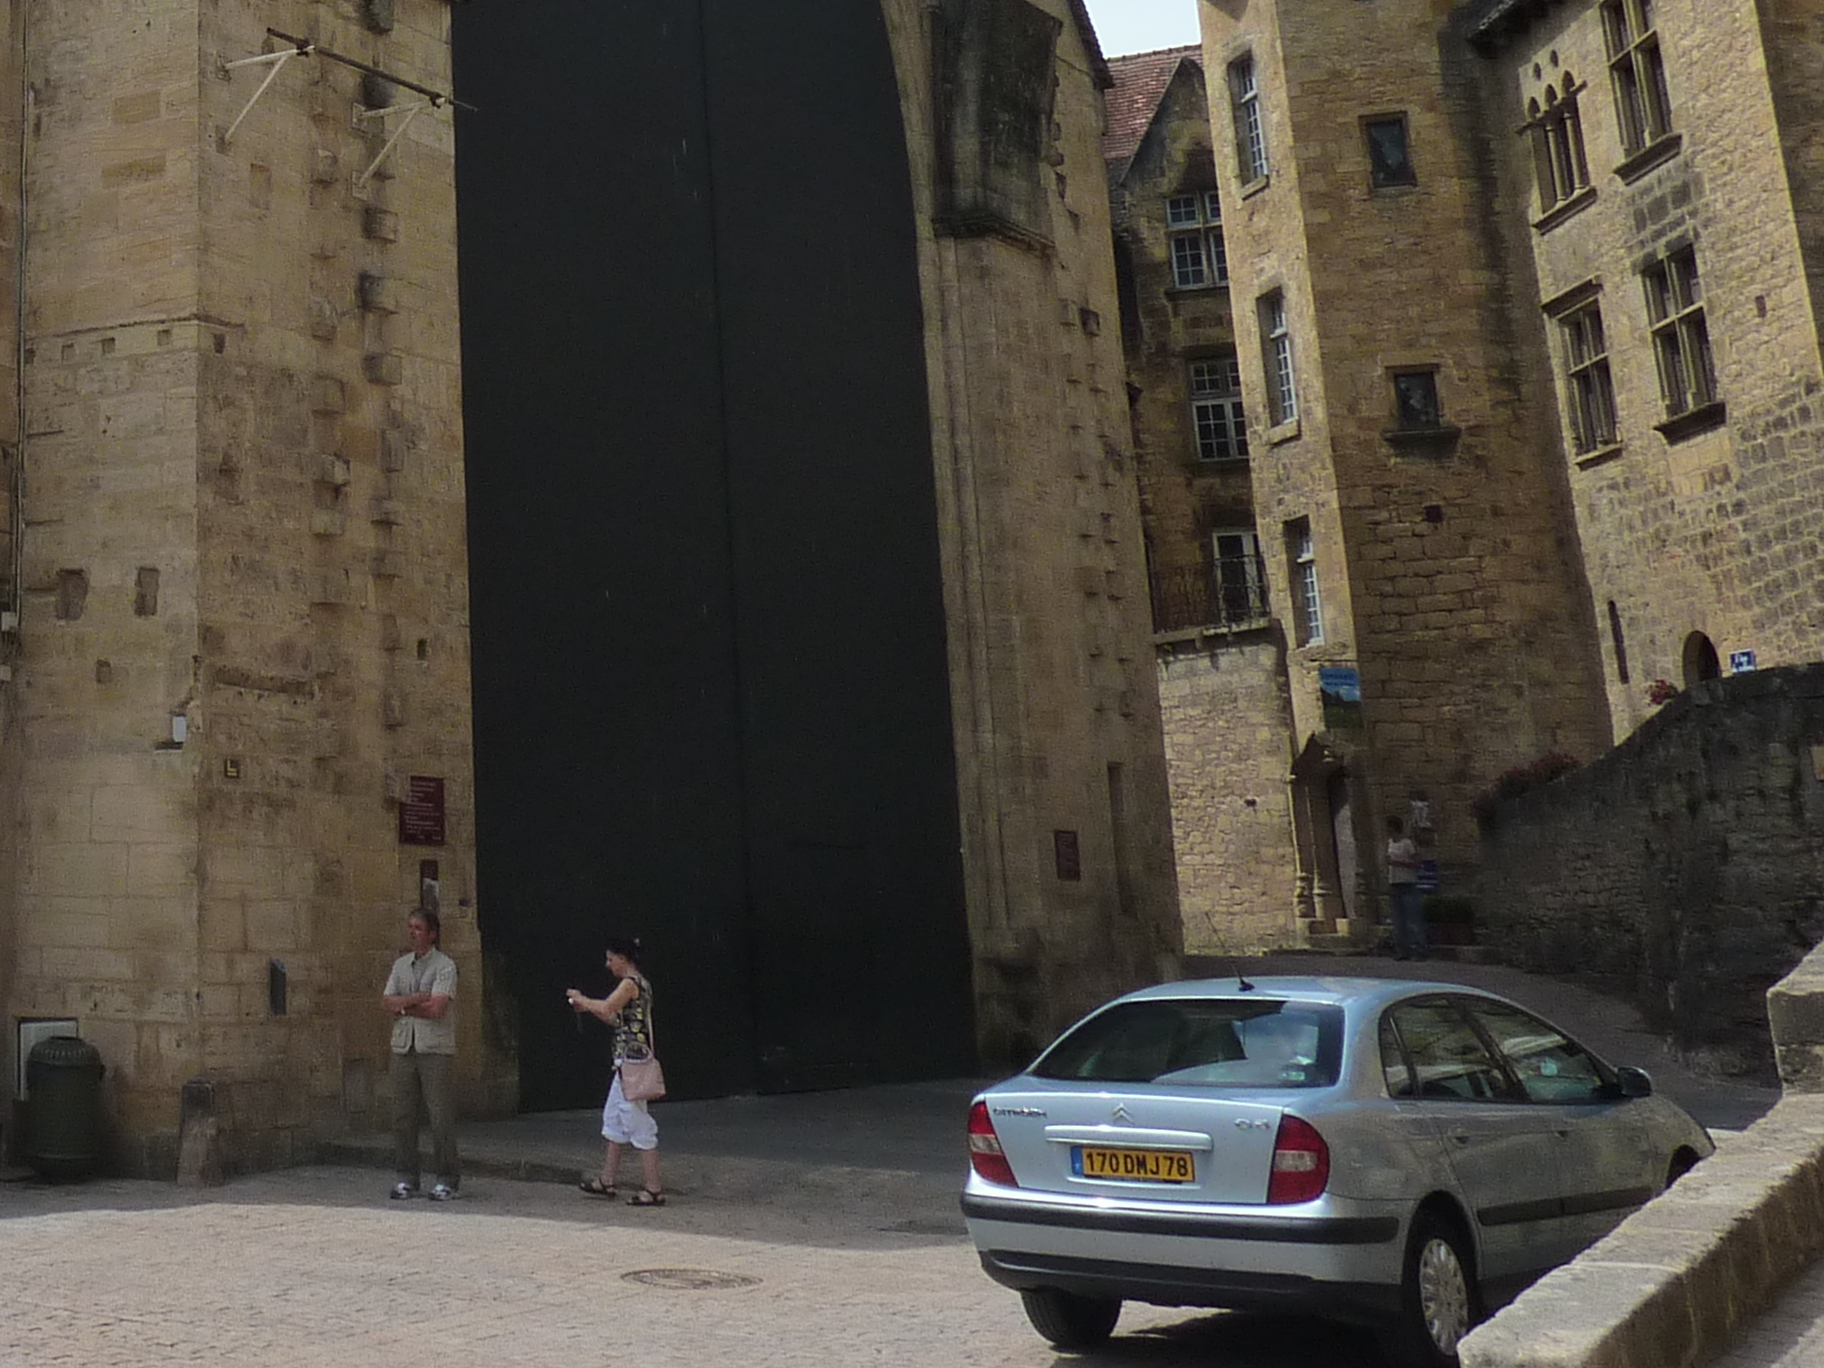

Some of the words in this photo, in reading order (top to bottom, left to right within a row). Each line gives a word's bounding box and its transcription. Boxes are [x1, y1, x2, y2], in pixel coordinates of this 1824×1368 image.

[1085, 1151, 1120, 1174] 170
[1123, 1154, 1161, 1176] DMJ
[1163, 1155, 1189, 1177] 78
